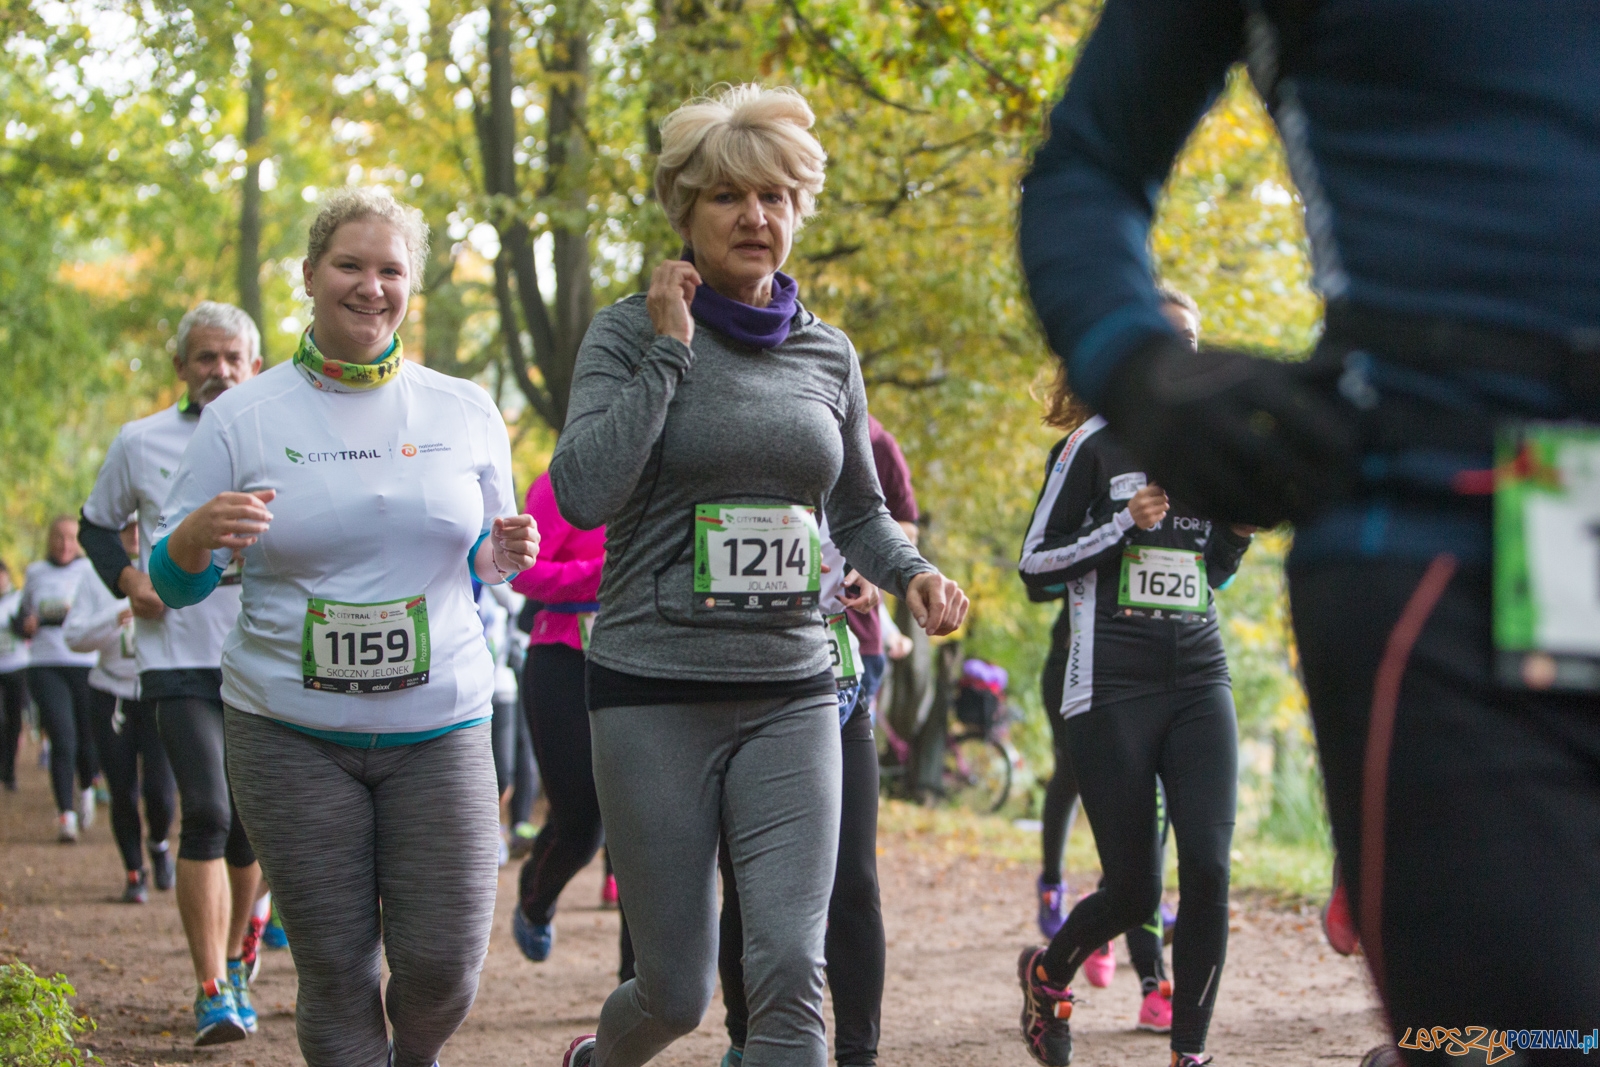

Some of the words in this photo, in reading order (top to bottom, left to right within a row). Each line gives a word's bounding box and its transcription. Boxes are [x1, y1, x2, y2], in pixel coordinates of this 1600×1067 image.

[723, 538, 806, 577] 1214
[747, 581, 788, 591] JOLANTA
[1137, 570, 1196, 599] 1626
[325, 629, 409, 666] 1159
[326, 667, 369, 678] SKOCZNY
[371, 665, 409, 678] JELONEK
